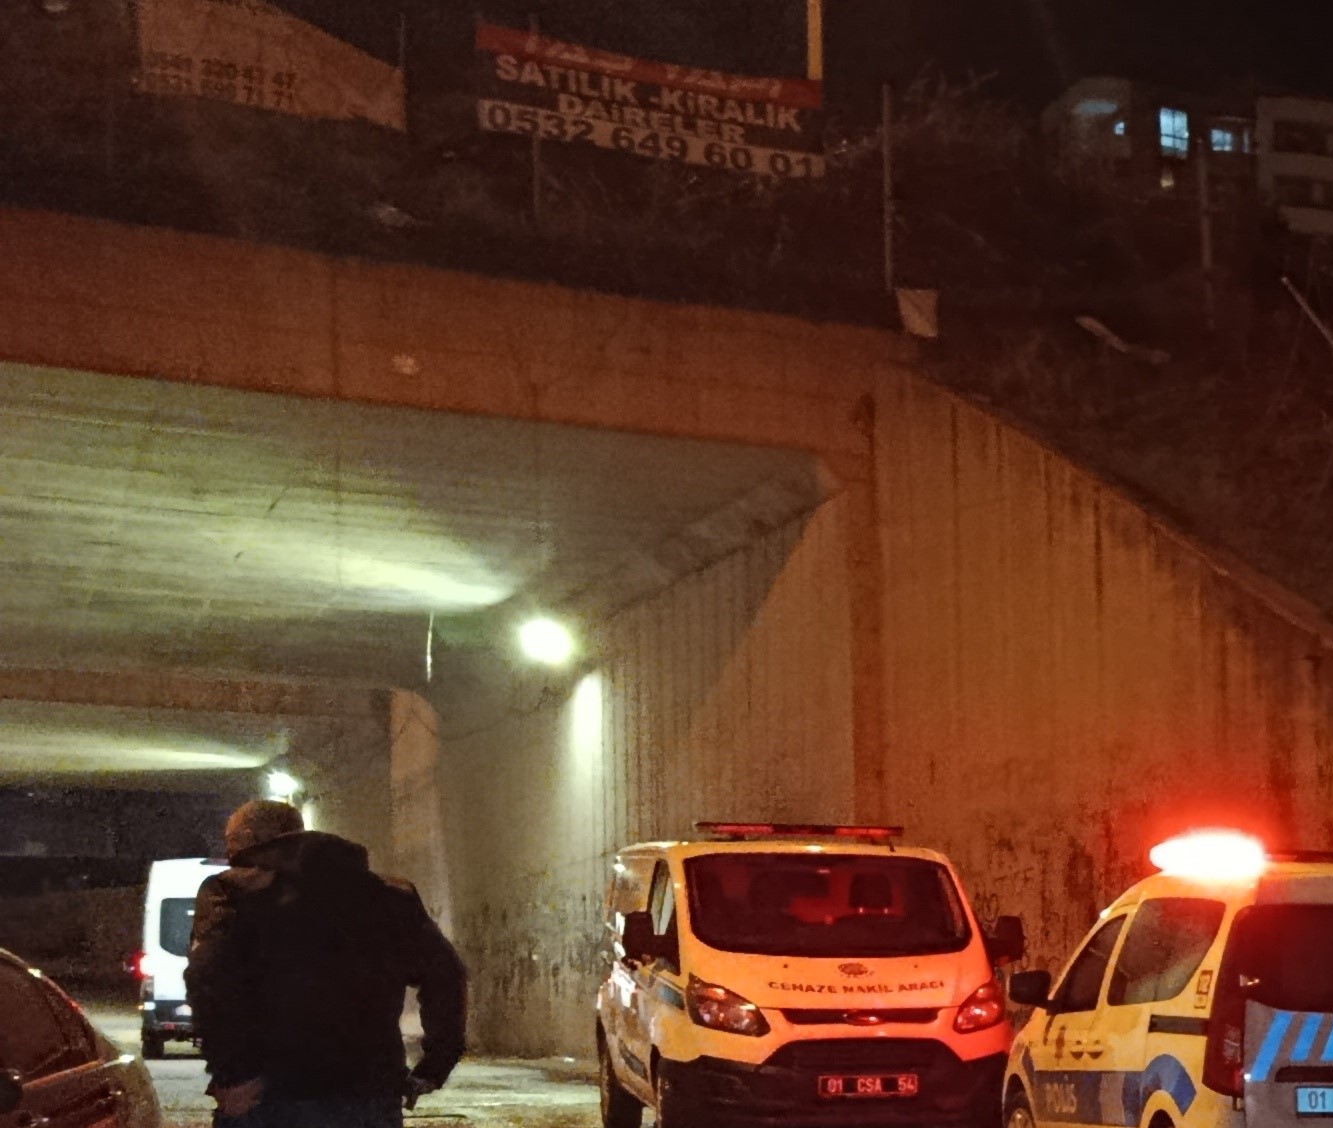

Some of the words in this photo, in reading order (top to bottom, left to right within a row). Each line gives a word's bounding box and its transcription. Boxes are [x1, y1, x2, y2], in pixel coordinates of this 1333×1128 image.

[487, 103, 594, 142] 0532
[611, 126, 688, 161] 649
[703, 143, 753, 171] 60
[769, 151, 813, 178] 01
[827, 1078, 842, 1093] 01
[857, 1078, 882, 1093] CSA
[898, 1077, 915, 1092] 54
[1307, 1090, 1326, 1110] 01
